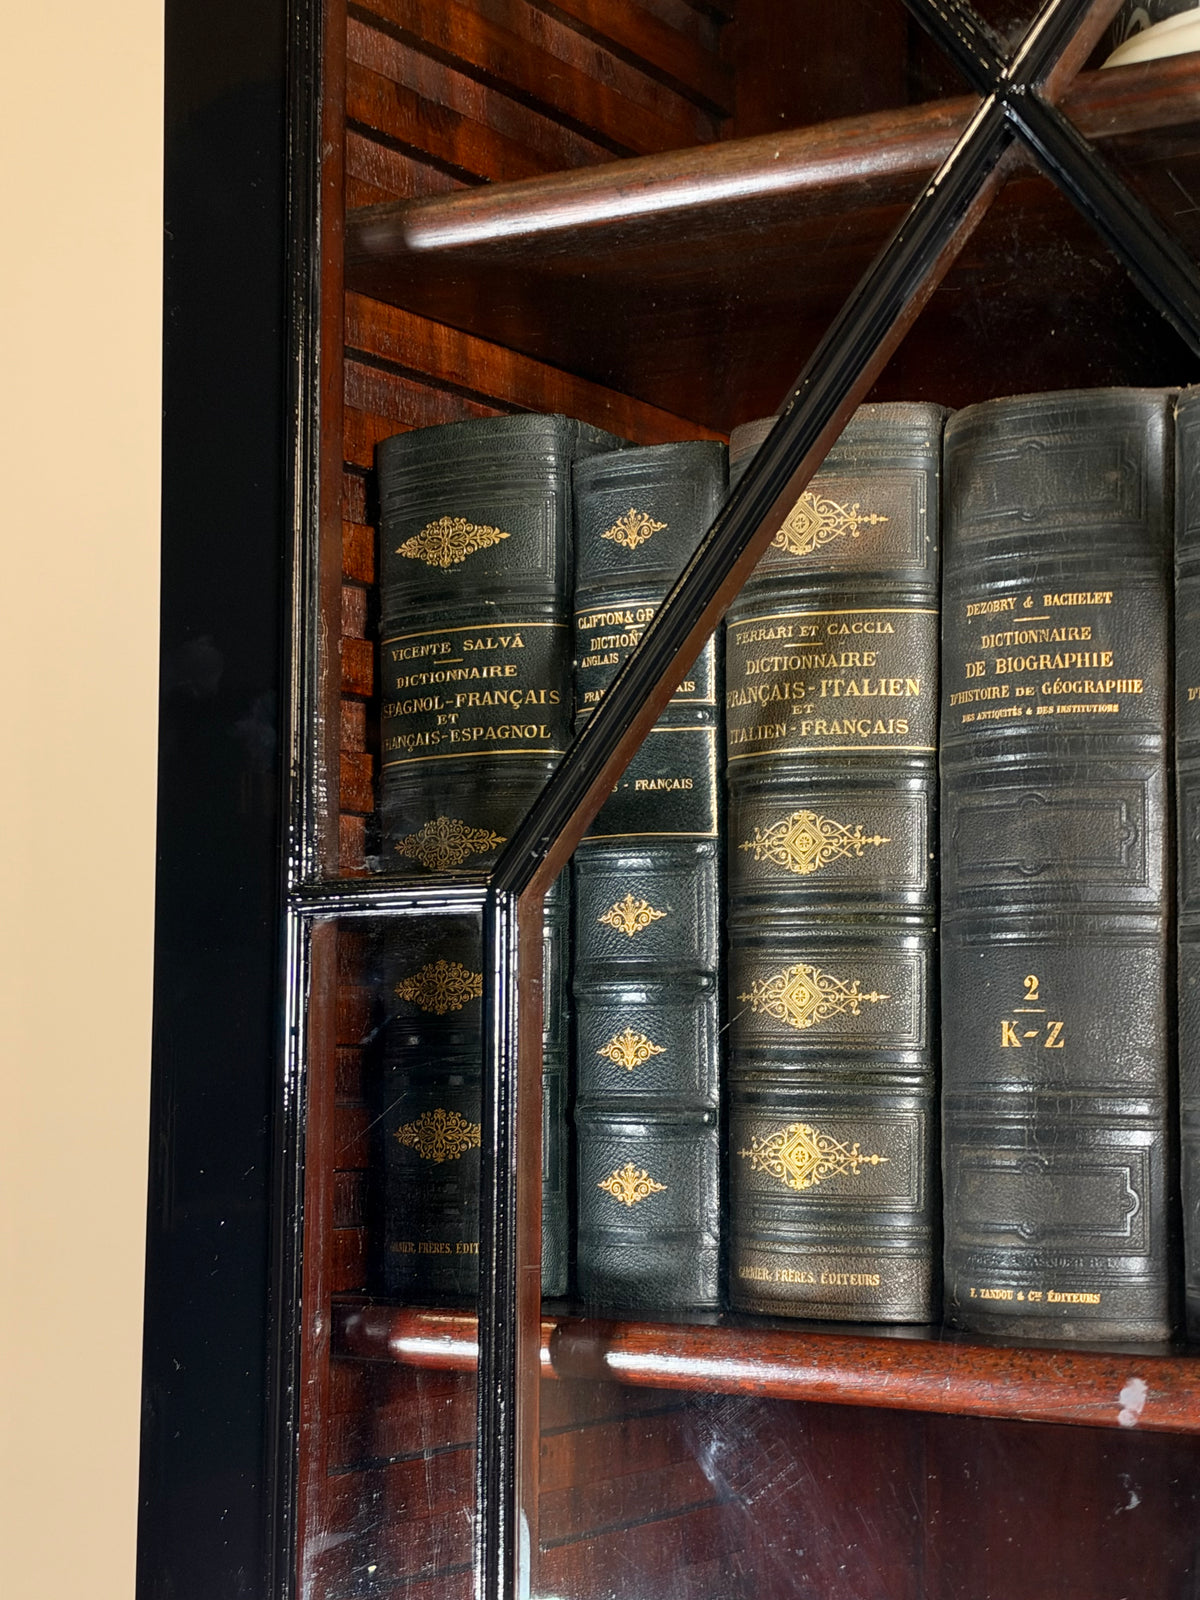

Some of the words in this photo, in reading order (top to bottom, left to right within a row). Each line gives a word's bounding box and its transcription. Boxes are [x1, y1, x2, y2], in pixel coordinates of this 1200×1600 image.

[966, 597, 1017, 617] DEZOBRY
[1023, 596, 1034, 609] &
[1043, 591, 1113, 607] BACHELET
[590, 629, 643, 651] DICTION
[736, 625, 793, 645] FERRARI
[799, 625, 819, 637] ET
[827, 622, 895, 635] CACCIA
[980, 626, 1092, 649] DICTIONNAIRE
[392, 641, 451, 662] VICENTE
[581, 652, 619, 668] ANGLAIS
[745, 651, 877, 675] DICTIONNAIRE
[965, 661, 986, 679] DE
[995, 651, 1114, 675] BIOGRAPHIE
[396, 664, 518, 689] DICTIONNAIRE
[950, 685, 1010, 707] D'HISTOIRE
[1015, 686, 1035, 698] DE
[1041, 678, 1144, 696] GÉOGRAPHIE
[383, 689, 561, 719] SPAGNOL-FRANÇAIS
[792, 704, 814, 715] ET
[1036, 705, 1054, 716] DES
[437, 713, 459, 726] ET
[635, 778, 694, 792] FRANÇAIS
[1023, 974, 1040, 1001] 2
[821, 1269, 881, 1286] ÉDITEURS
[1047, 1289, 1101, 1304] ÉDITEURS
